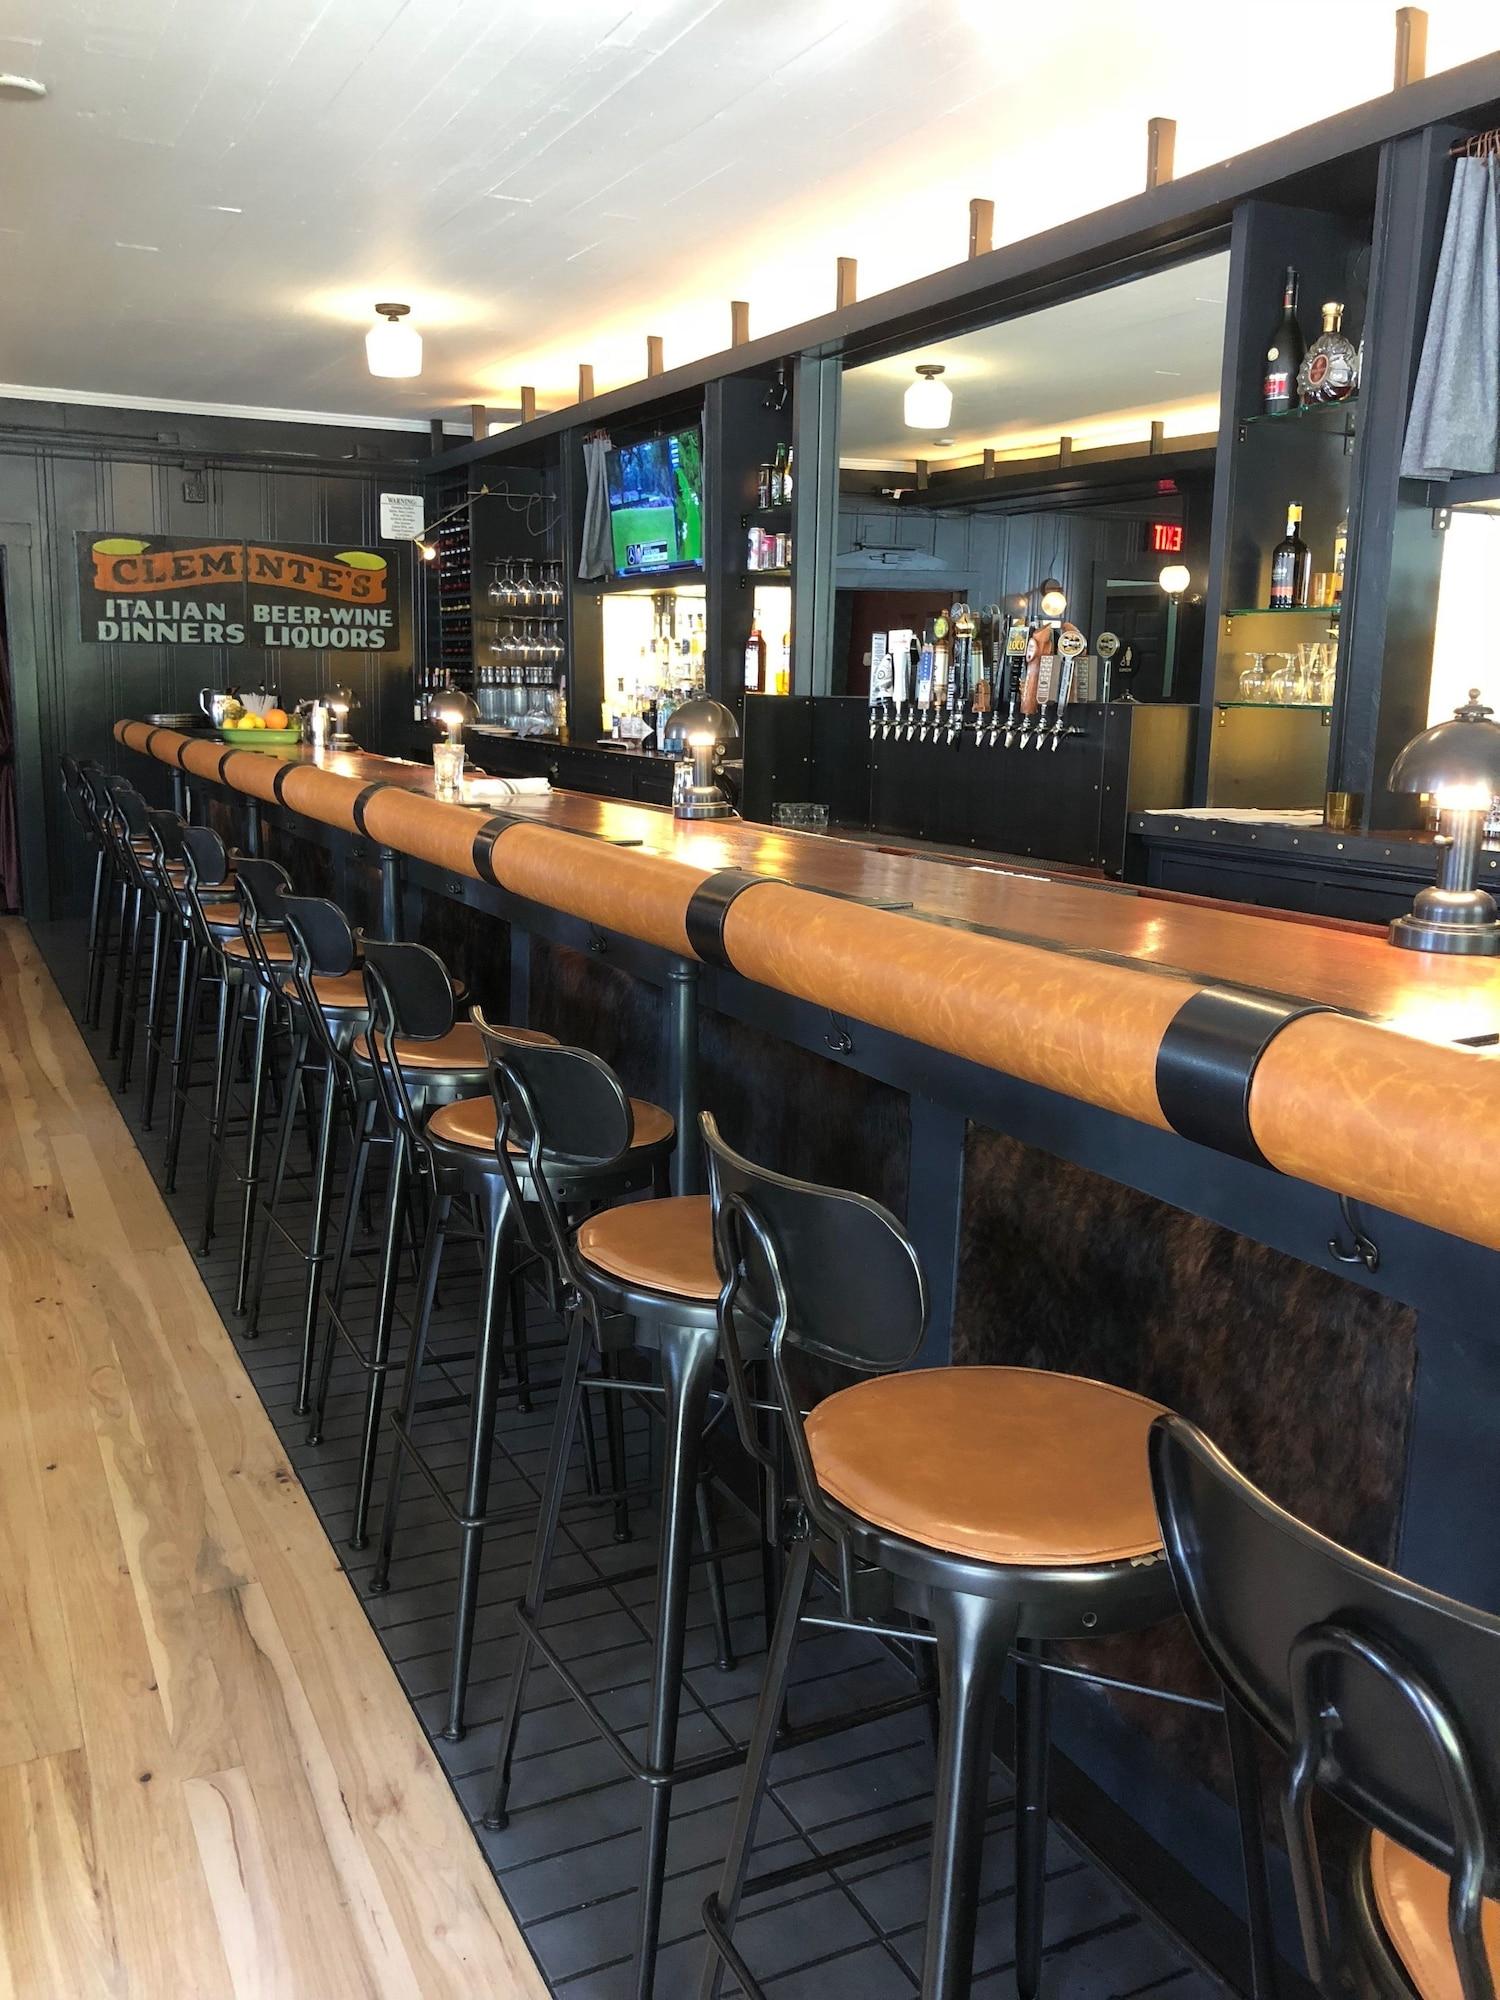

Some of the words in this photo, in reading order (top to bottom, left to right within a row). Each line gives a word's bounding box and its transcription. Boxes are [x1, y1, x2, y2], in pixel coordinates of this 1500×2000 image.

[112, 551, 371, 598] CLEMNTE'S
[106, 599, 225, 621] ITALIAN
[253, 605, 393, 627] BEER-WINE
[98, 620, 245, 643] DINNERS
[265, 626, 386, 649] LIQUORS
